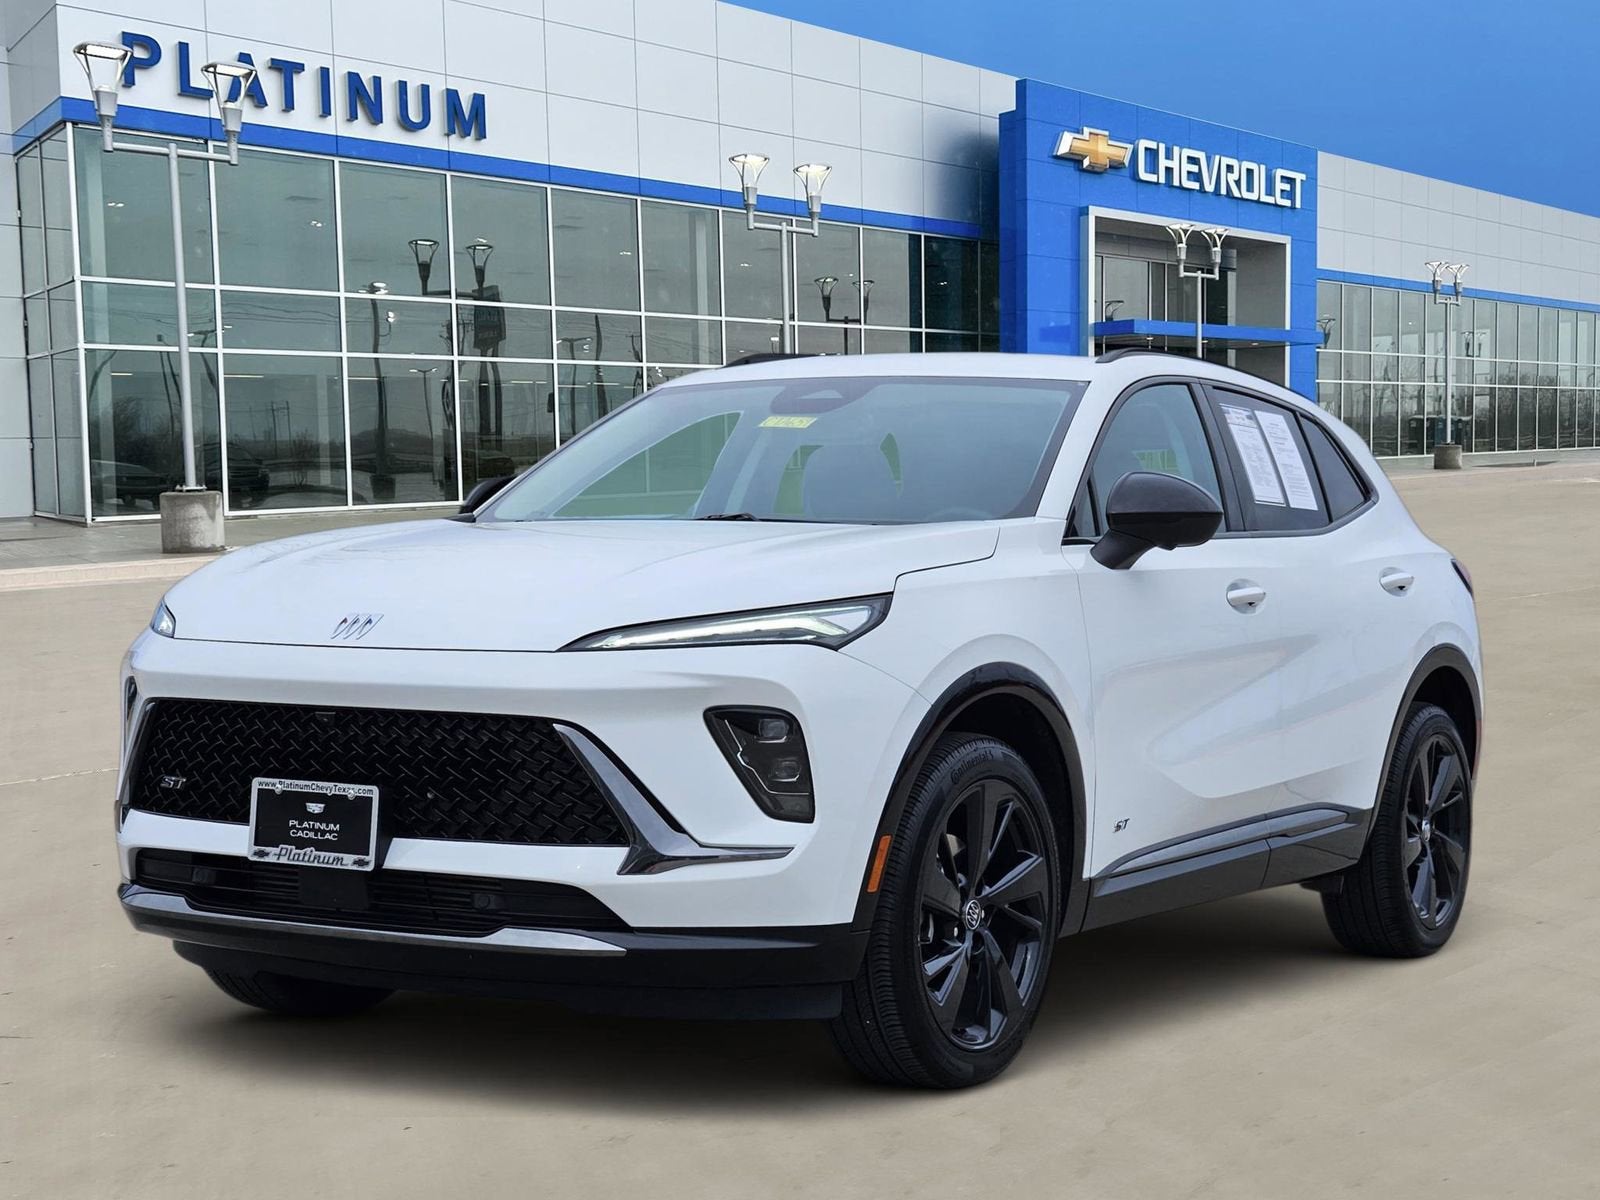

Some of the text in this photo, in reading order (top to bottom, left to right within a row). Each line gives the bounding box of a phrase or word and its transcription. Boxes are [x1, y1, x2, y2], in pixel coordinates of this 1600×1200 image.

[120, 31, 487, 140] PLATINUM
[1137, 138, 1306, 208] CHEVROLET
[160, 775, 186, 789] ST
[257, 780, 374, 796] wwwPlatinumChevyTexas.com
[288, 819, 340, 832] PLATINUM
[1112, 817, 1130, 833] ST
[289, 829, 338, 841] CADILLAC
[272, 847, 349, 867] Platinum
